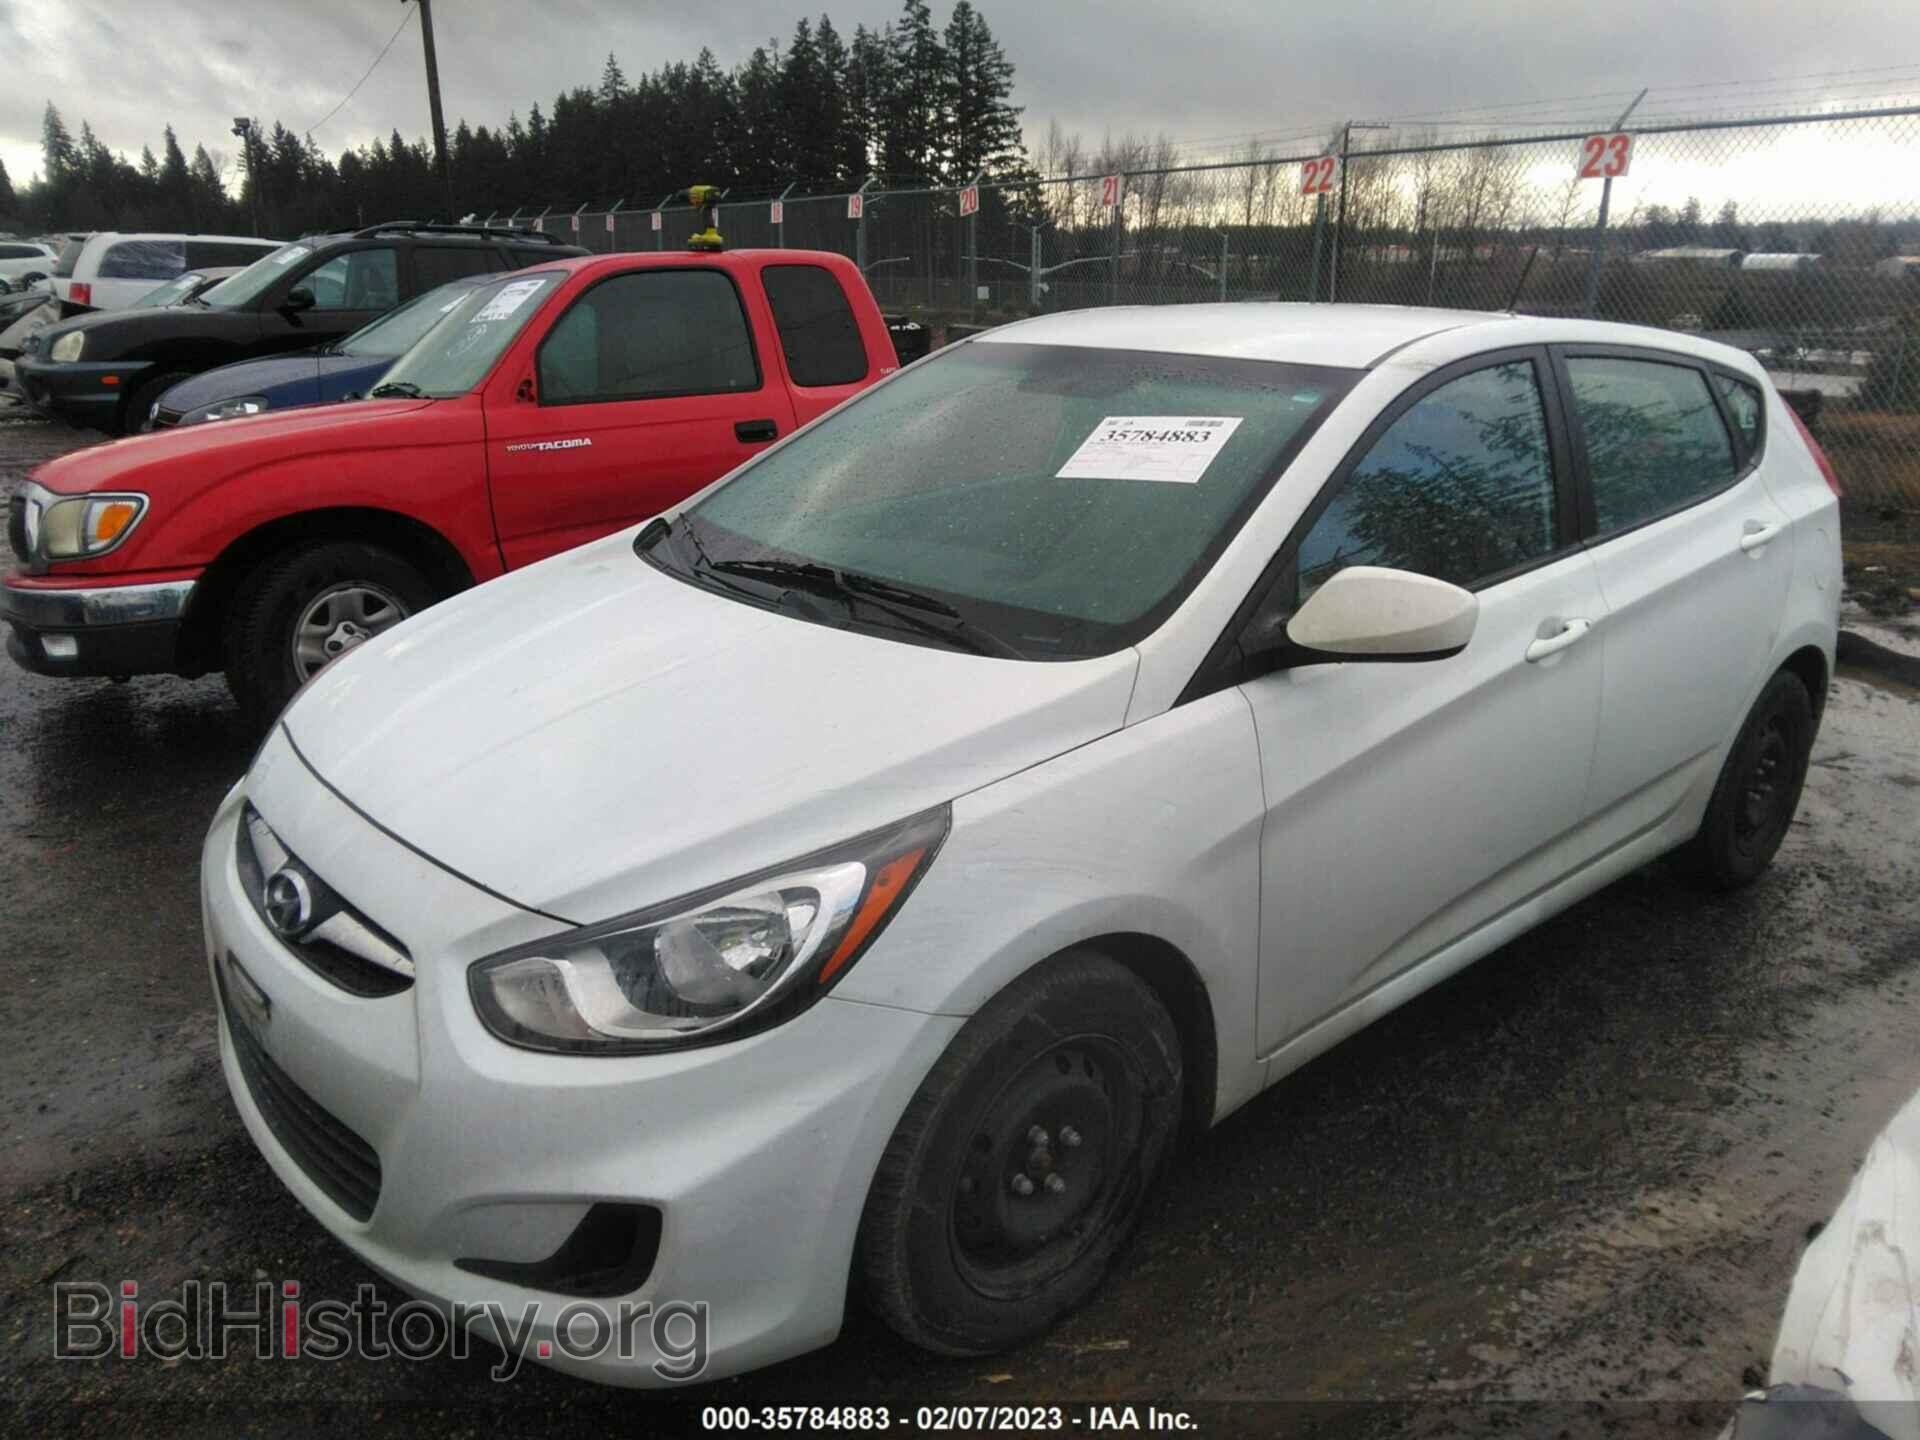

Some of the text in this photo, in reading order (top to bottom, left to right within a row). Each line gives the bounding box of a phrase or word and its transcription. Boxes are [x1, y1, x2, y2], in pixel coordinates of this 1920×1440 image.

[1581, 134, 1631, 178] 23
[1302, 158, 1335, 194] 22
[962, 188, 977, 213] 20
[1103, 178, 1119, 205] 21
[850, 196, 861, 216] 19
[539, 438, 592, 450] TACOMA
[1100, 430, 1211, 443] 35784883
